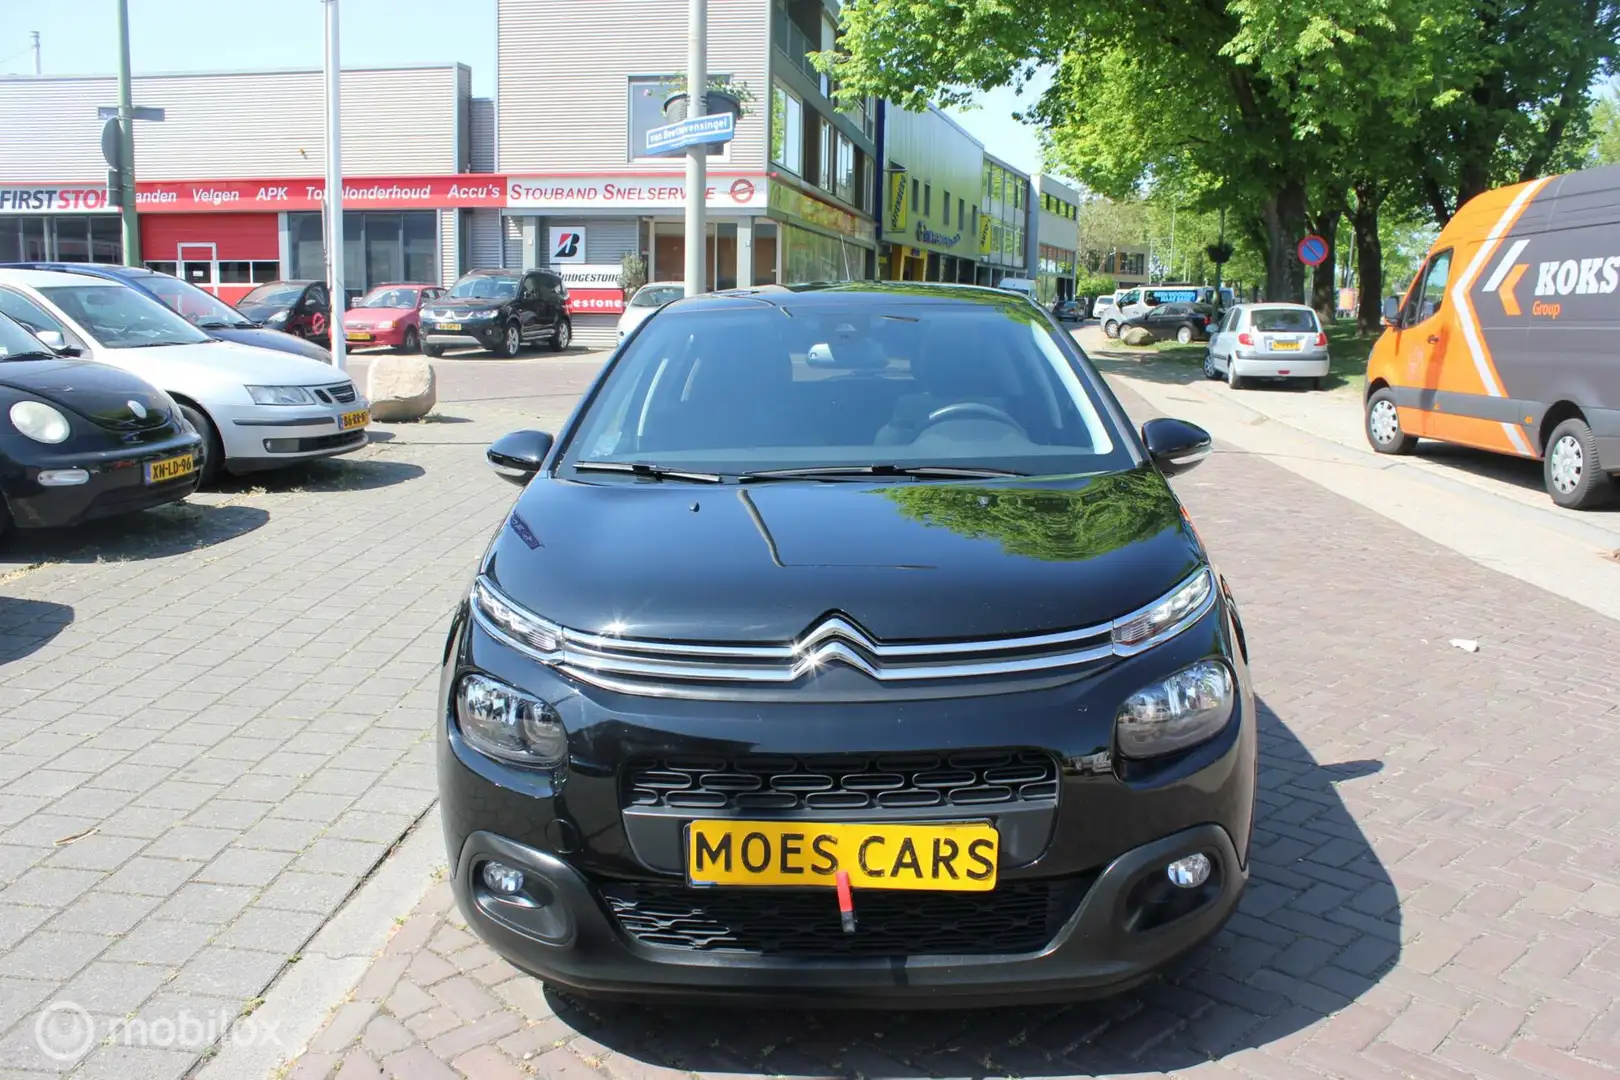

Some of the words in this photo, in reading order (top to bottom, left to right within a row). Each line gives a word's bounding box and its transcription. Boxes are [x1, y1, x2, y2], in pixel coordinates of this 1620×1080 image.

[136, 189, 177, 204] anden
[192, 188, 240, 207] Velgen
[256, 187, 288, 201] APK
[305, 184, 432, 200] Totlonderhoud
[447, 184, 500, 199] Accu's
[510, 183, 598, 200] STOUBAND
[603, 183, 716, 201] SNELSERVE
[1534, 255, 1620, 296] KOKS
[573, 298, 623, 309] estone
[1532, 300, 1561, 320] Group
[152, 456, 192, 480] XN-LD-96
[695, 830, 839, 875] MOES
[858, 835, 995, 880] CARS
